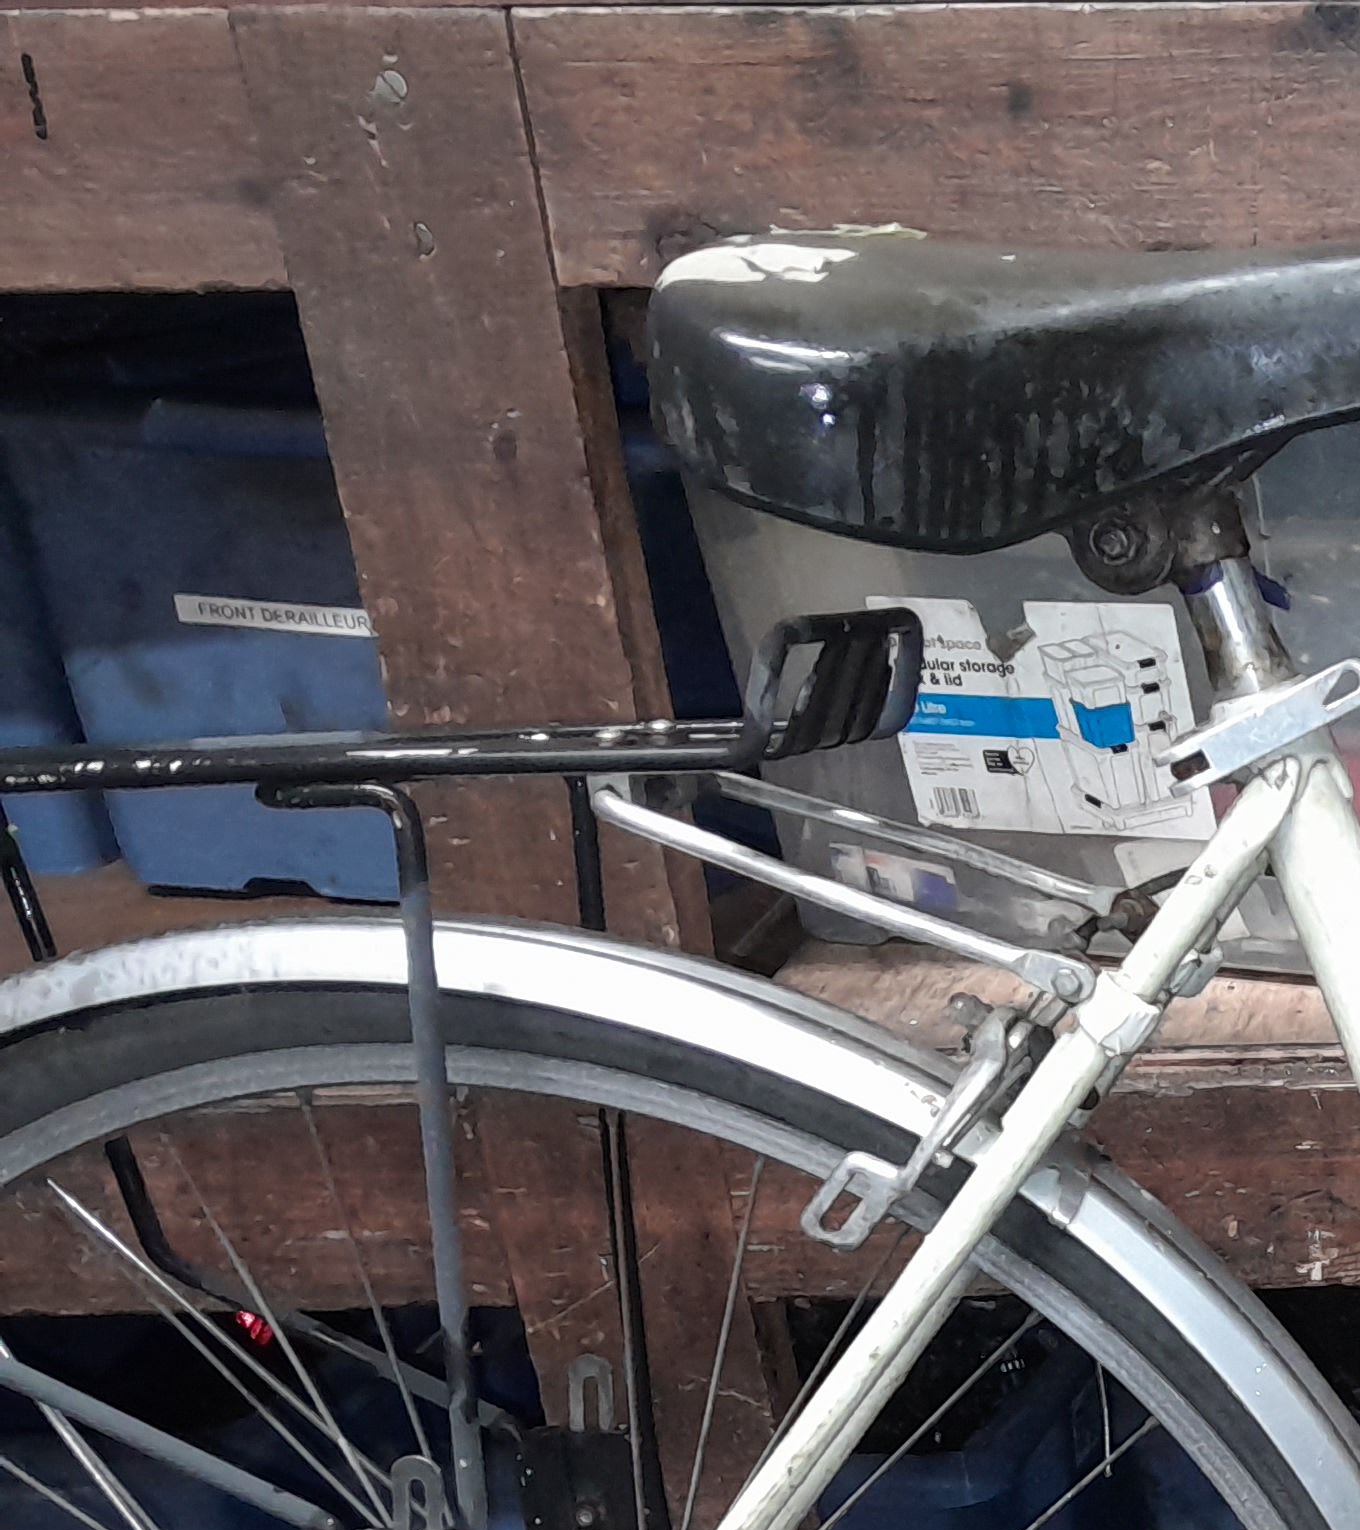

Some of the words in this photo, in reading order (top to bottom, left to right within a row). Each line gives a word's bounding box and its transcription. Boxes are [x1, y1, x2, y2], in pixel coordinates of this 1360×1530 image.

[197, 601, 256, 621] FRONT
[261, 606, 369, 630] DERAILLEUR
[960, 658, 1015, 678] storage
